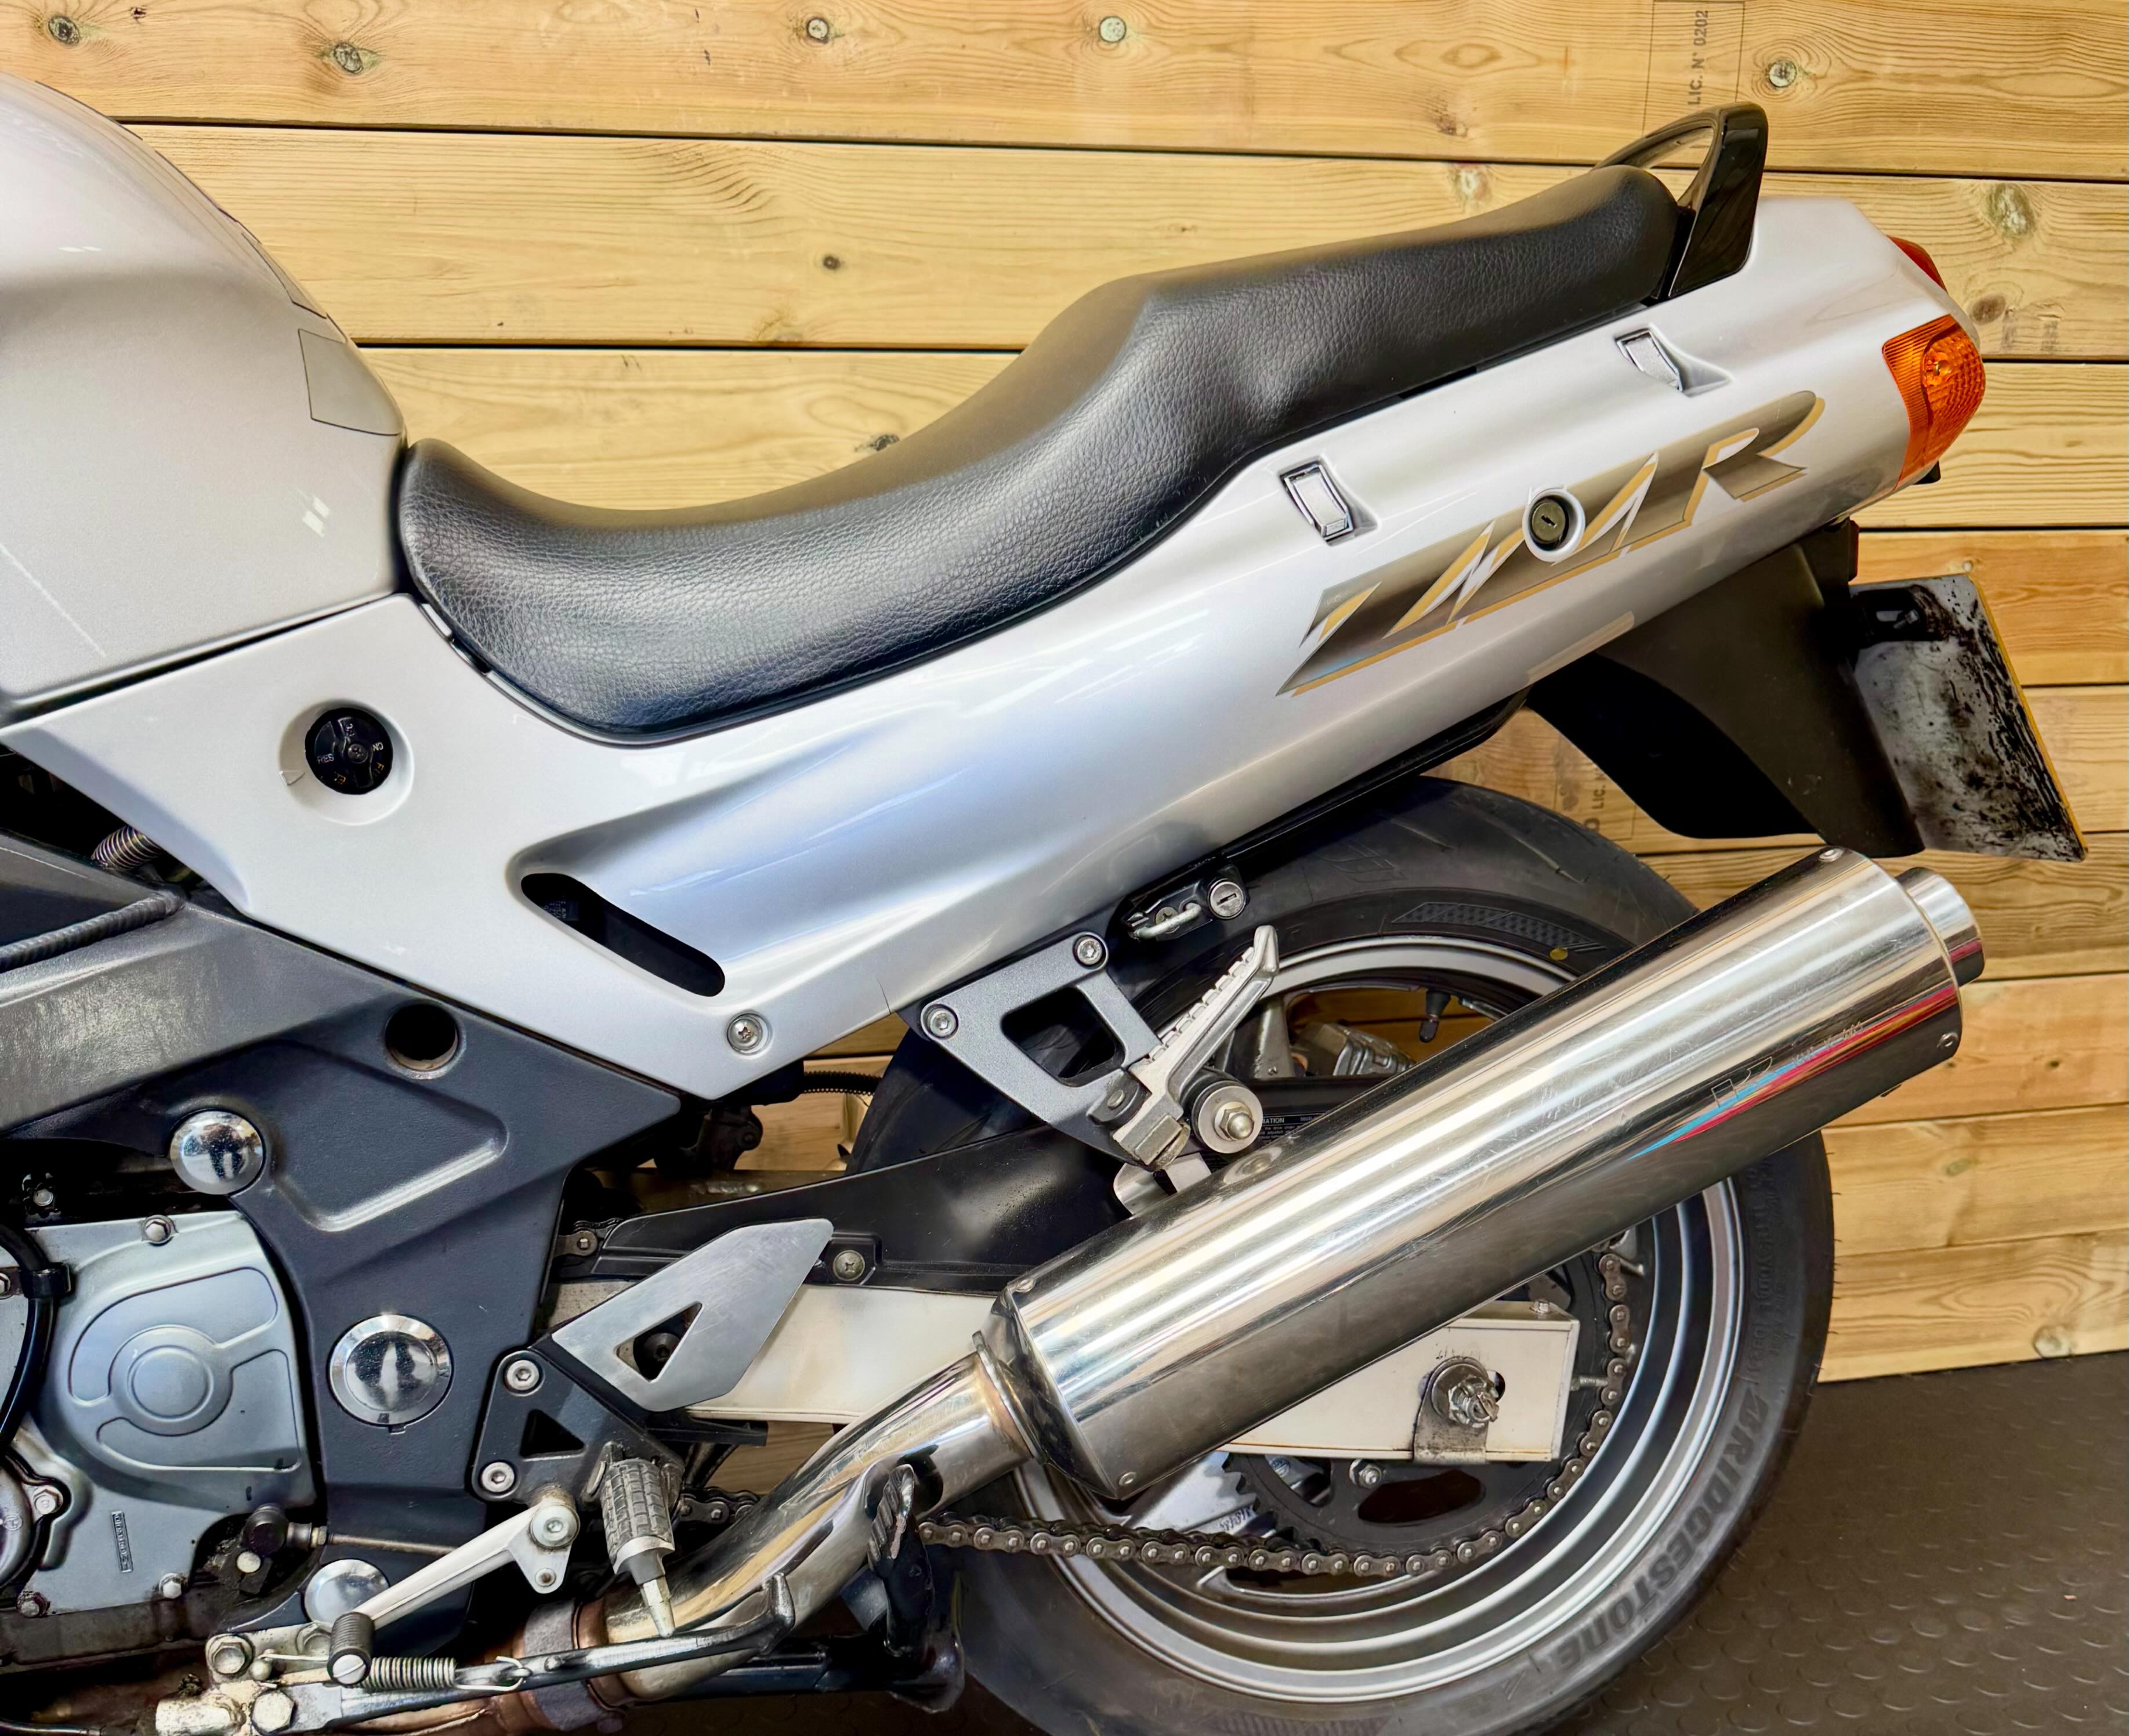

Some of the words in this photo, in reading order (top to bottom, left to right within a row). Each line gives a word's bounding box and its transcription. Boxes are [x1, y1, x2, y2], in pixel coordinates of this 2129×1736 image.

[1694, 10, 1708, 46] 0202
[1688, 76, 1703, 105] LIC.
[1592, 785, 1606, 809] LIC.
[1555, 1387, 1769, 1667] BRIDGESTONE
